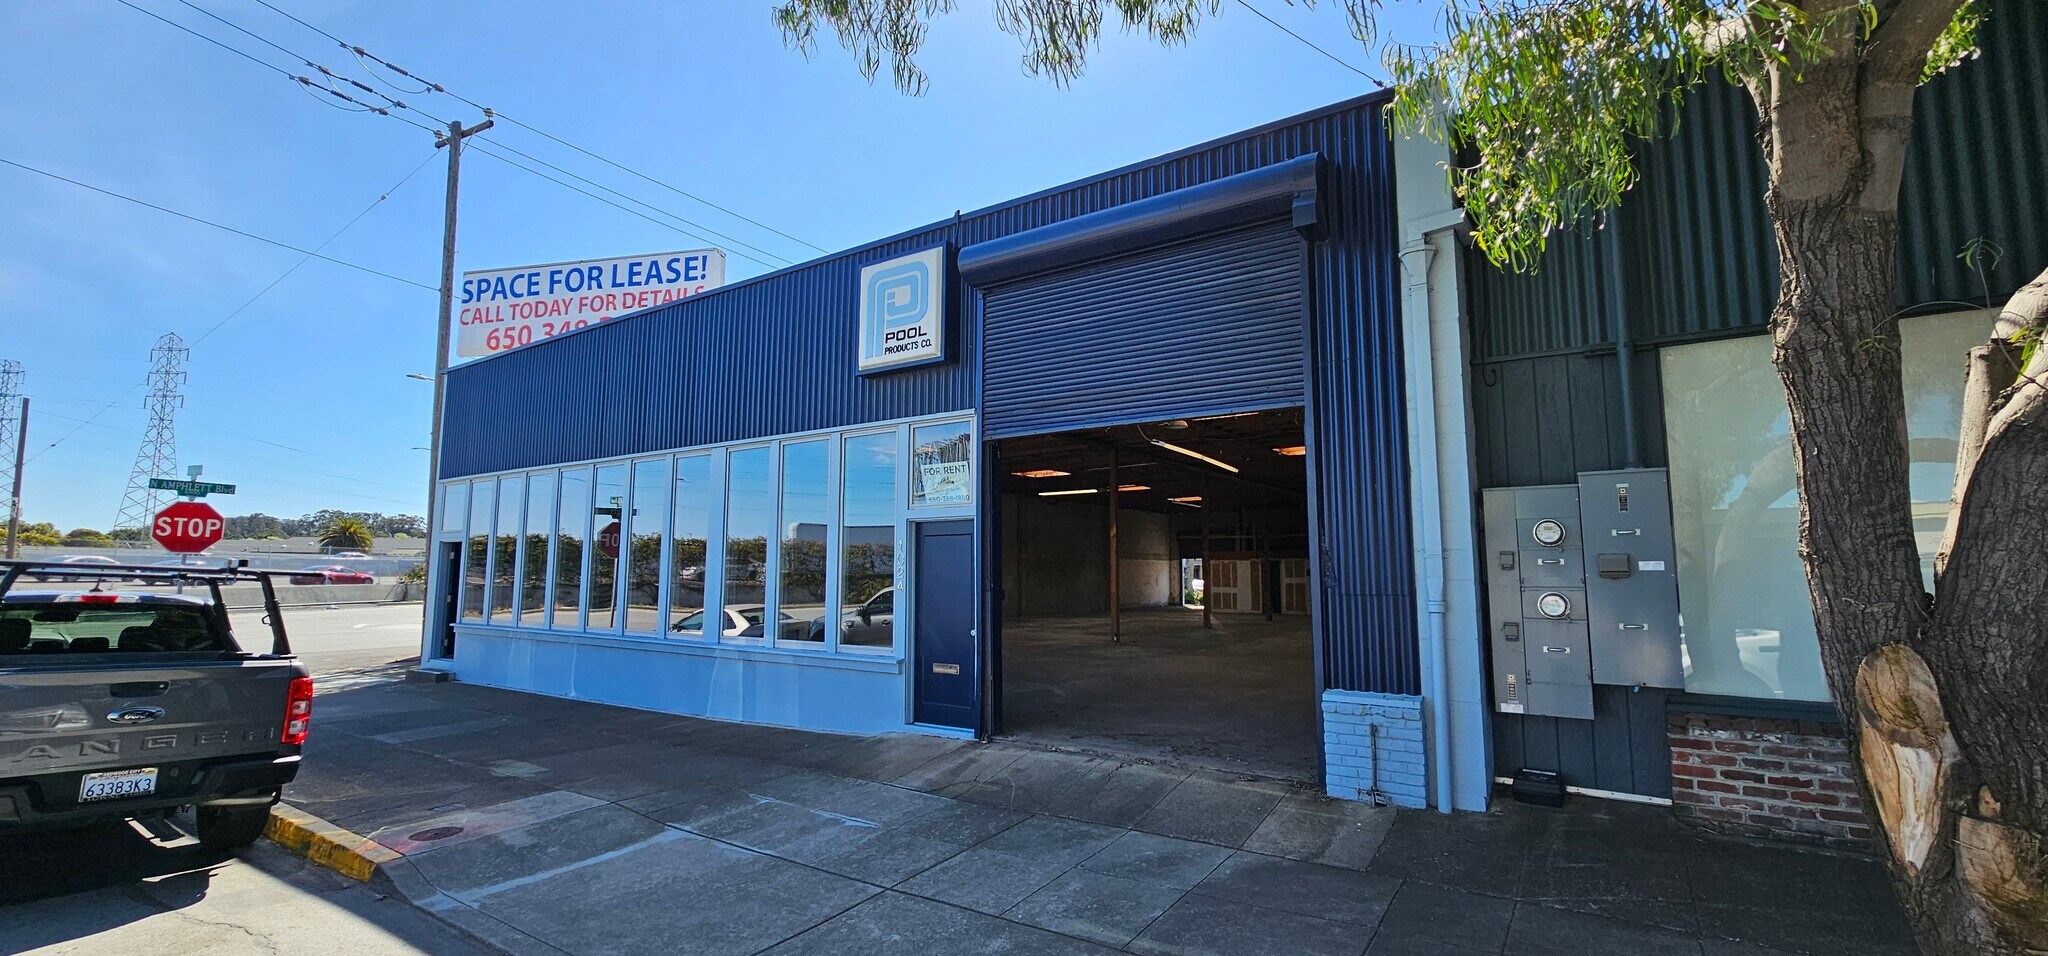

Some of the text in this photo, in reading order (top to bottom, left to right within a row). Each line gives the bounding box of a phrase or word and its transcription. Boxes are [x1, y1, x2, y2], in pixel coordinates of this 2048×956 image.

[462, 255, 708, 303] SPACE FOR LEASE!
[459, 306, 505, 326] CALL
[509, 298, 572, 320] TODAY
[578, 294, 617, 314] FOR
[486, 325, 531, 350] 650
[885, 325, 928, 344] POOL
[885, 342, 918, 355] PRODUCTS
[923, 464, 966, 476] FOR RENT
[150, 480, 157, 488] N
[161, 481, 213, 493] AMPHLETT
[215, 486, 235, 494] Blvd
[156, 517, 221, 537] STOP
[11, 727, 274, 762] ANGER
[86, 779, 151, 797] 63383K3
